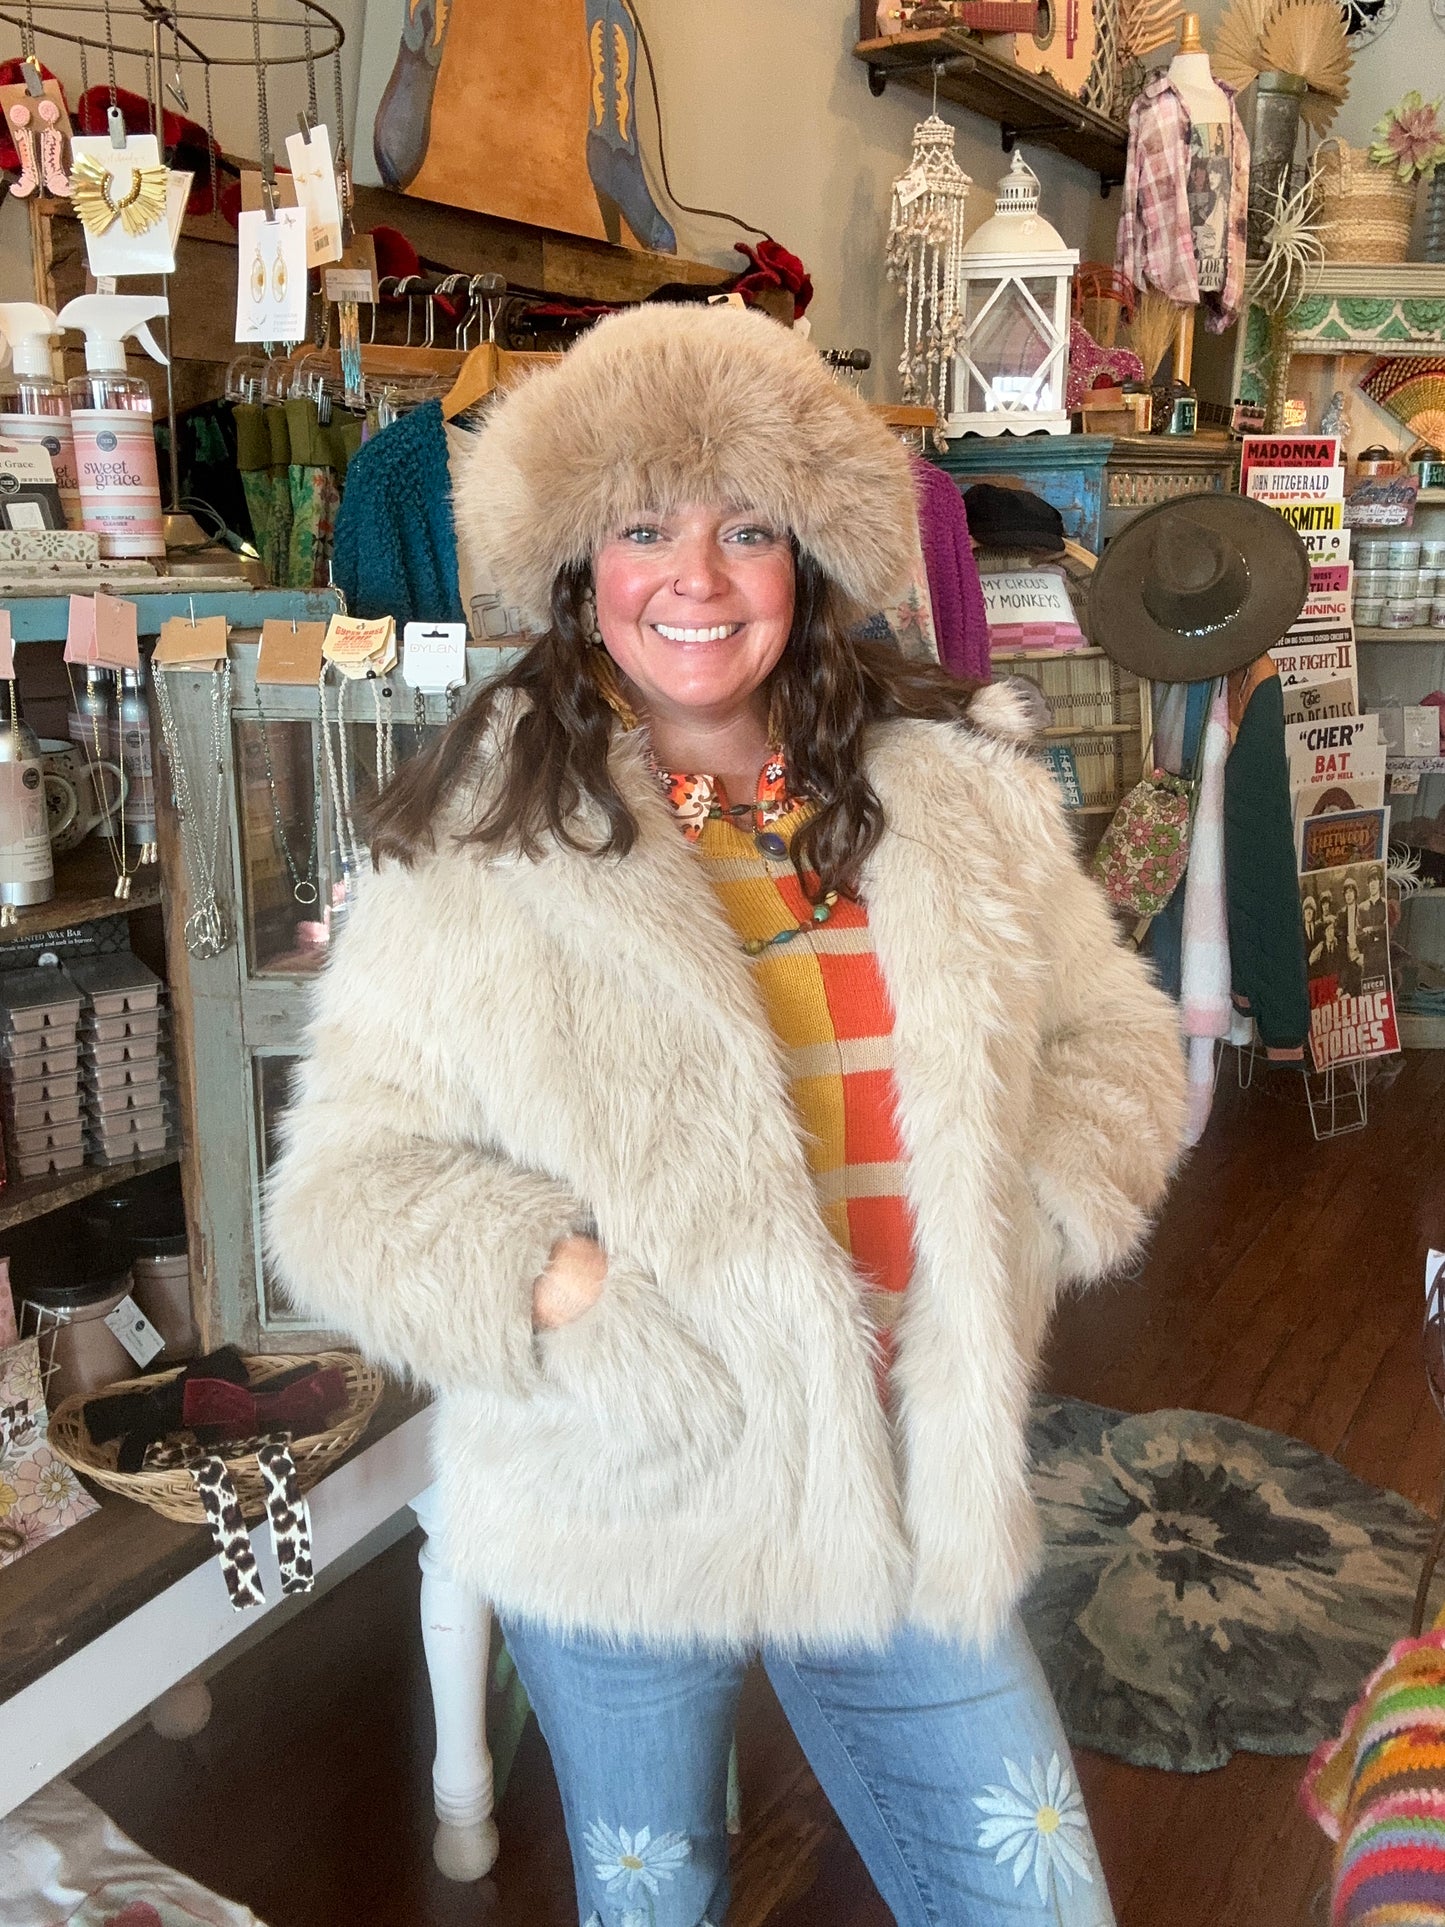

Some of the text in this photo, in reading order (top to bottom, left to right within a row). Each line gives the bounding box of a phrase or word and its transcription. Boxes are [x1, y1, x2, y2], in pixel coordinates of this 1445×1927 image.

[1248, 443, 1329, 459] MADONNA
[84, 460, 129, 474] sweet
[57, 477, 78, 489] ace
[95, 474, 141, 491] grace
[1252, 474, 1329, 490] JOHN FITZGERALD
[1005, 579, 1049, 590] CIRCUS
[1000, 594, 1061, 609] MONKEYS
[1302, 603, 1346, 615] HINING
[1276, 656, 1297, 672] PER
[1299, 653, 1338, 671] FIGHT
[1315, 752, 1351, 774] BAT
[1310, 771, 1354, 784] OUT OF HELL
[29, 942, 44, 950] apart
[1311, 991, 1390, 1037] ROLLING
[1314, 1021, 1386, 1067] STONES
